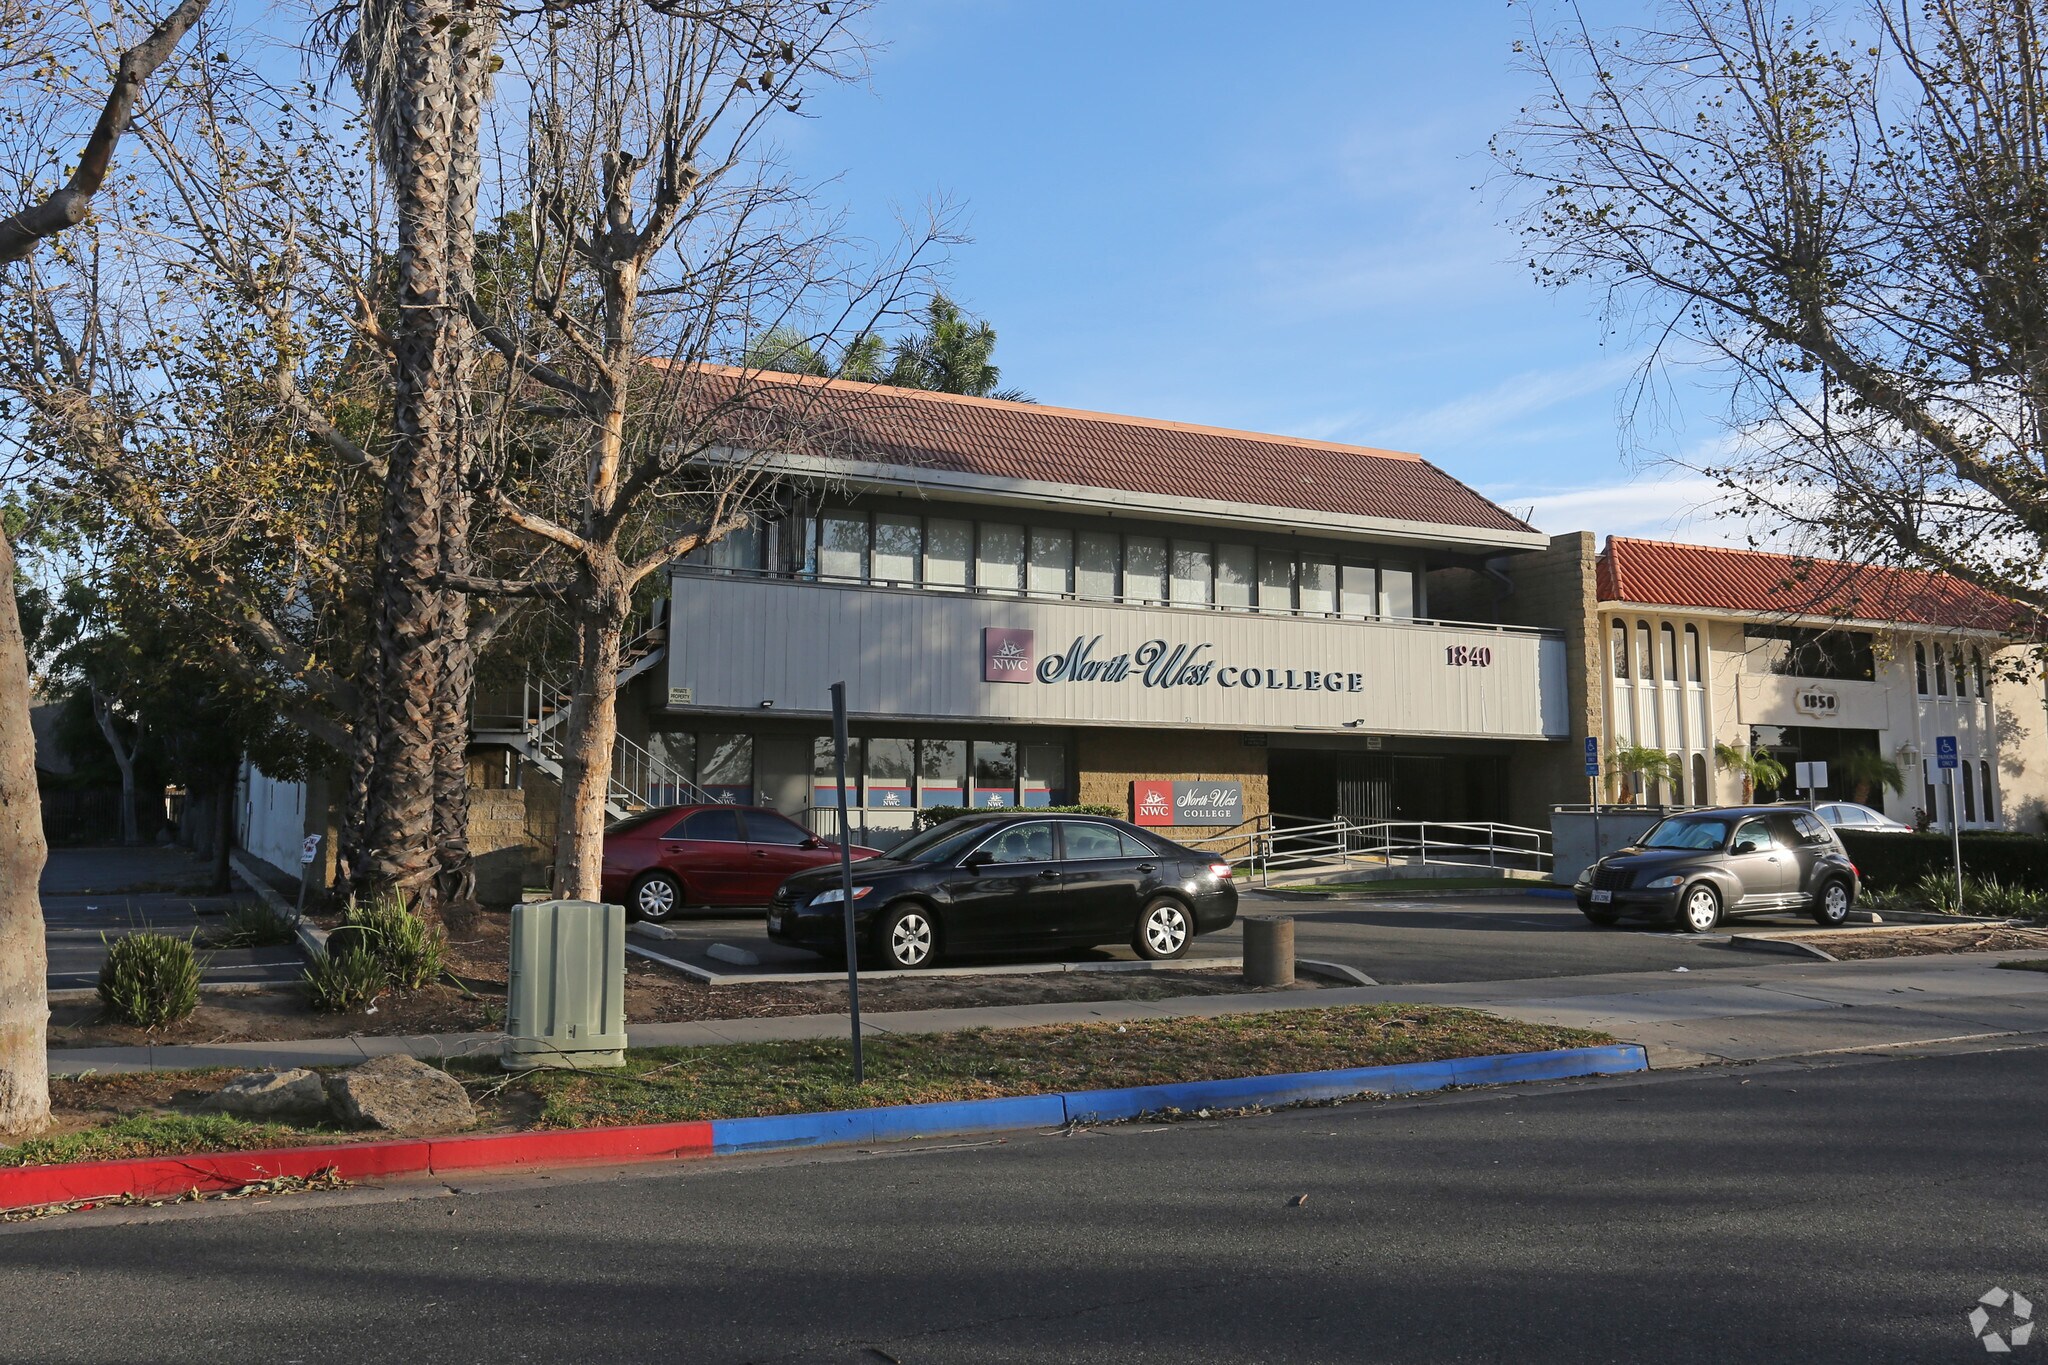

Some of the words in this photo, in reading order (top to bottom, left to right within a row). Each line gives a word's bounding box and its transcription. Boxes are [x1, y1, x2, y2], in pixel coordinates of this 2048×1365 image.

[1445, 645, 1493, 668] 1840
[992, 658, 1029, 672] NWC
[1217, 666, 1365, 692] COLLEGE
[1803, 694, 1835, 709] 1850
[1140, 806, 1169, 816] NWC
[1183, 809, 1231, 818] COLLEGE
